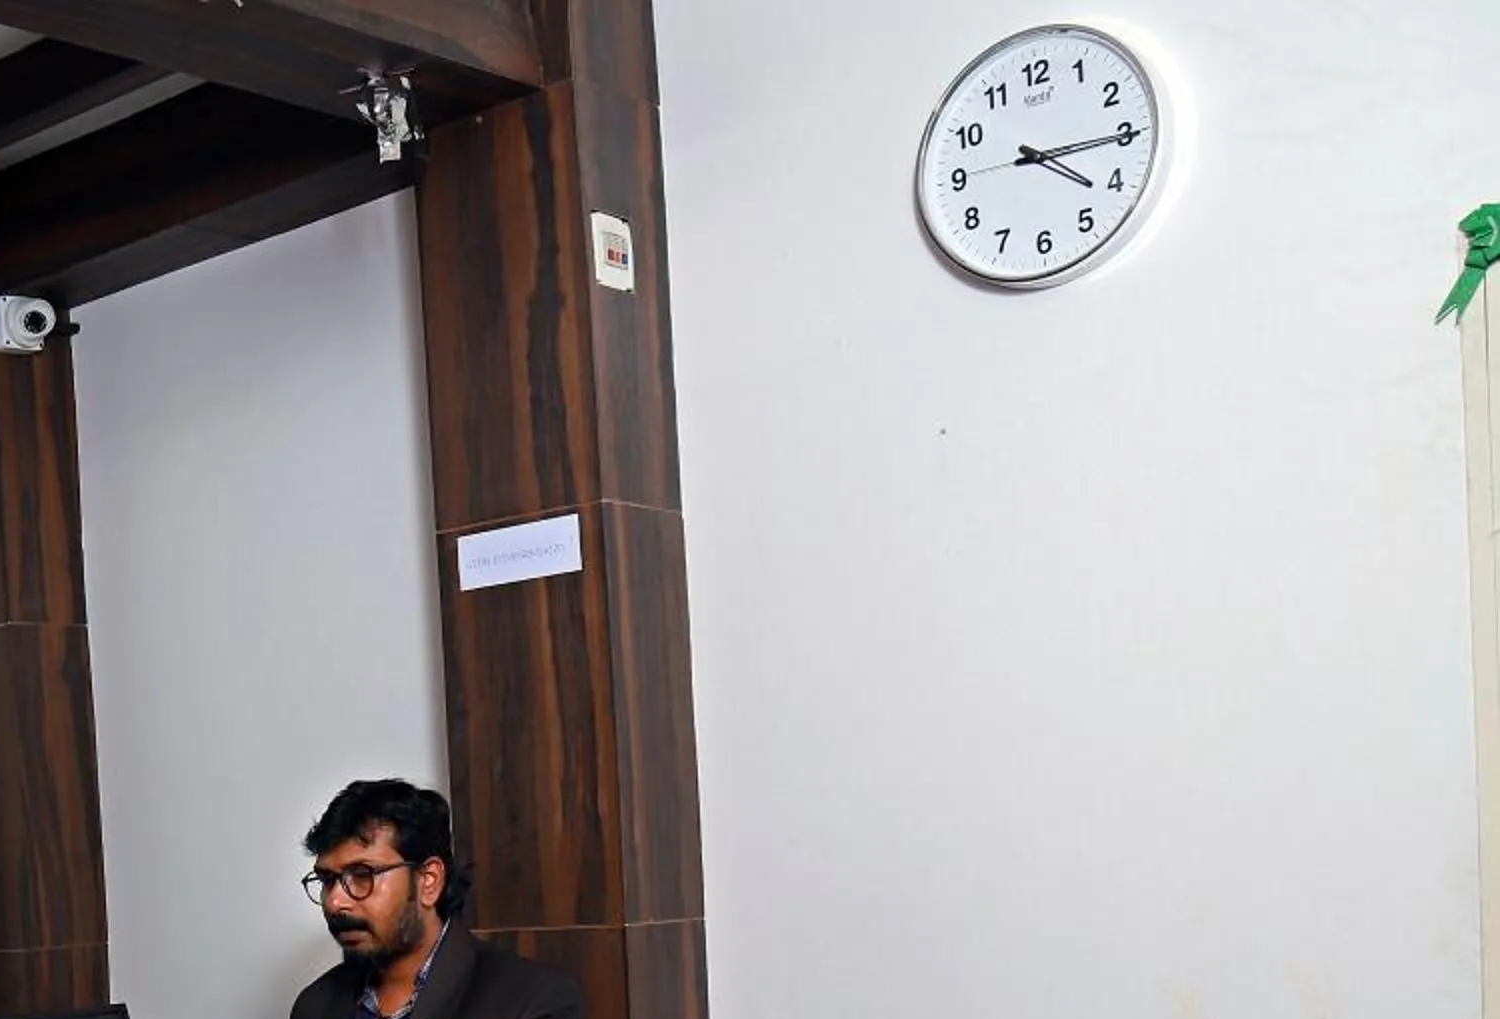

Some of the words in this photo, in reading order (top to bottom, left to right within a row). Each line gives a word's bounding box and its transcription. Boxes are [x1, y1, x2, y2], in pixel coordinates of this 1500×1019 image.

[1022, 59, 1050, 87] 12
[1072, 59, 1084, 83] 1
[983, 83, 1008, 110] 11
[1102, 81, 1120, 108] 2
[955, 123, 983, 149] 10
[1116, 121, 1134, 147] 3
[951, 168, 967, 192] 9
[1107, 167, 1124, 193] 4
[964, 206, 980, 231] 8
[1077, 207, 1094, 233] 5
[994, 228, 1011, 254] 7
[1036, 230, 1053, 255] 6
